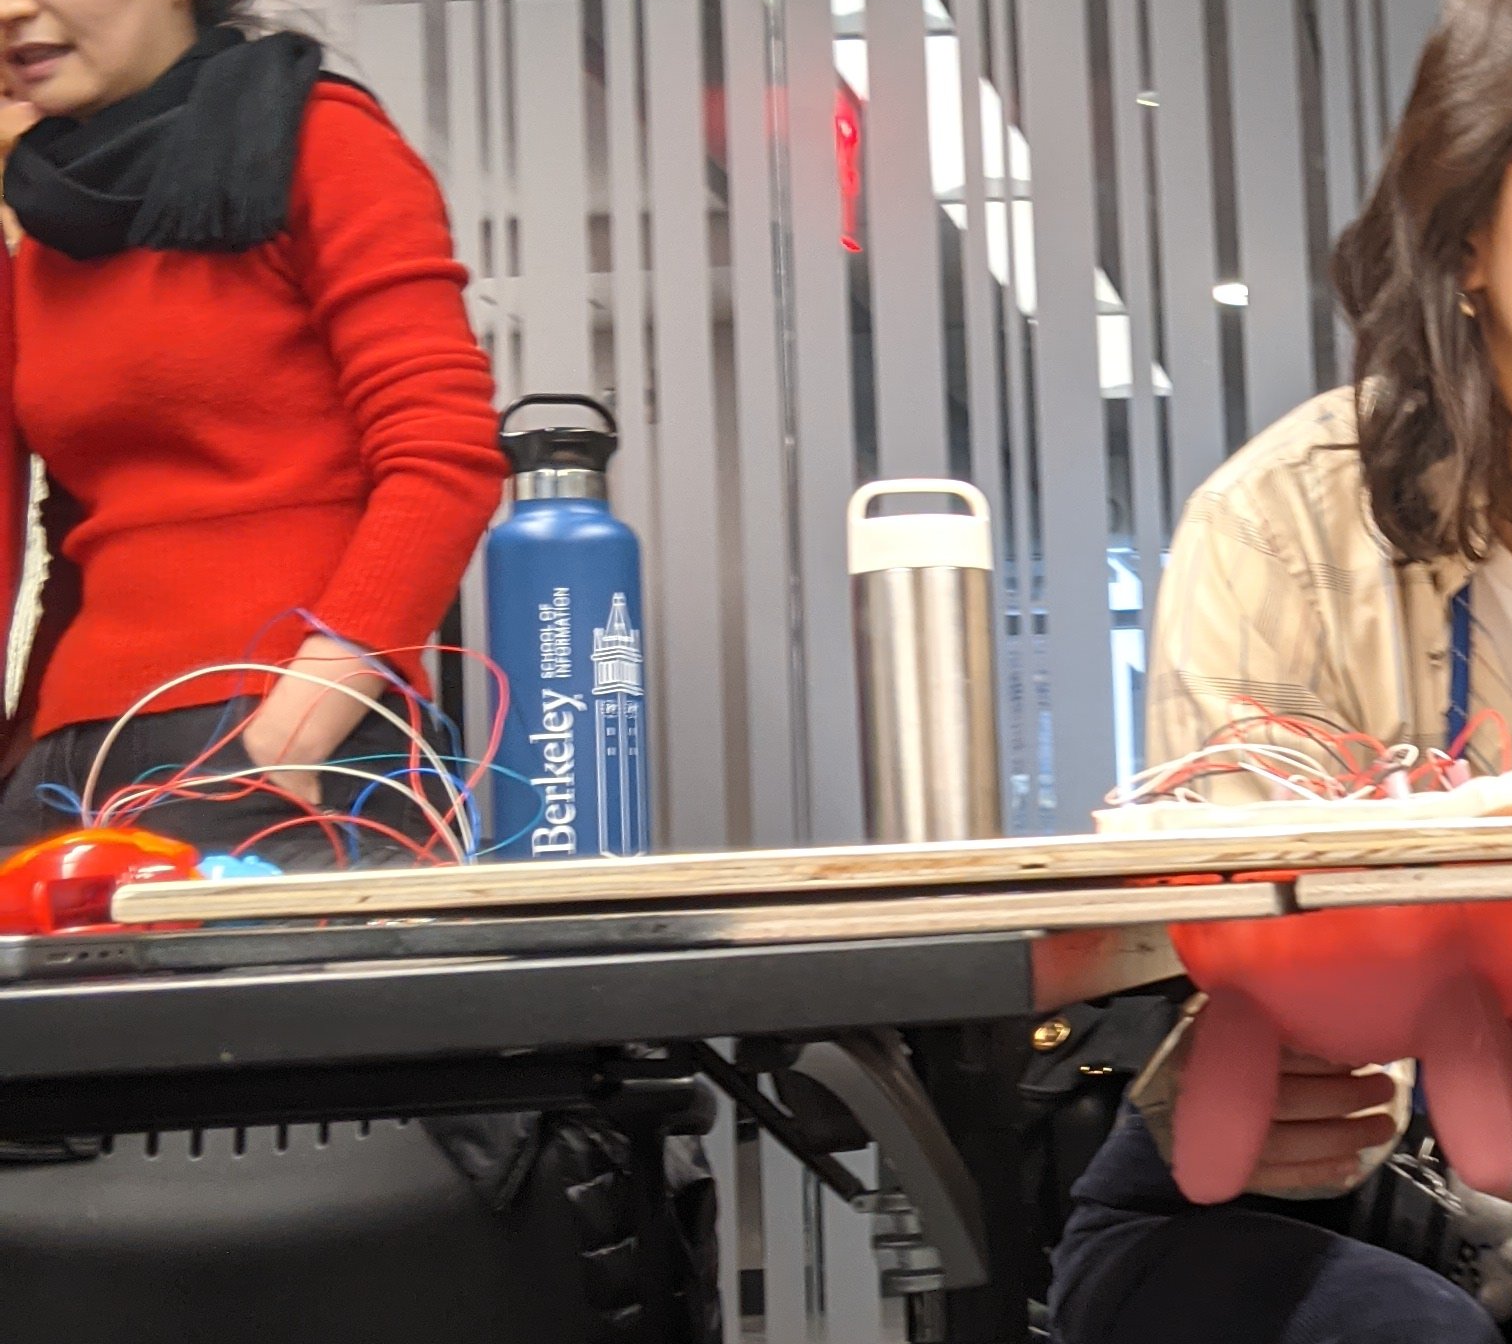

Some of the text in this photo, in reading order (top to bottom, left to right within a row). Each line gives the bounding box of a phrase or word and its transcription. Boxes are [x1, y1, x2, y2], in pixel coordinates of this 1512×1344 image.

[538, 603, 555, 679] SCHOOL OF
[553, 586, 572, 678] INFORMATION
[529, 688, 588, 858] Berkeley
